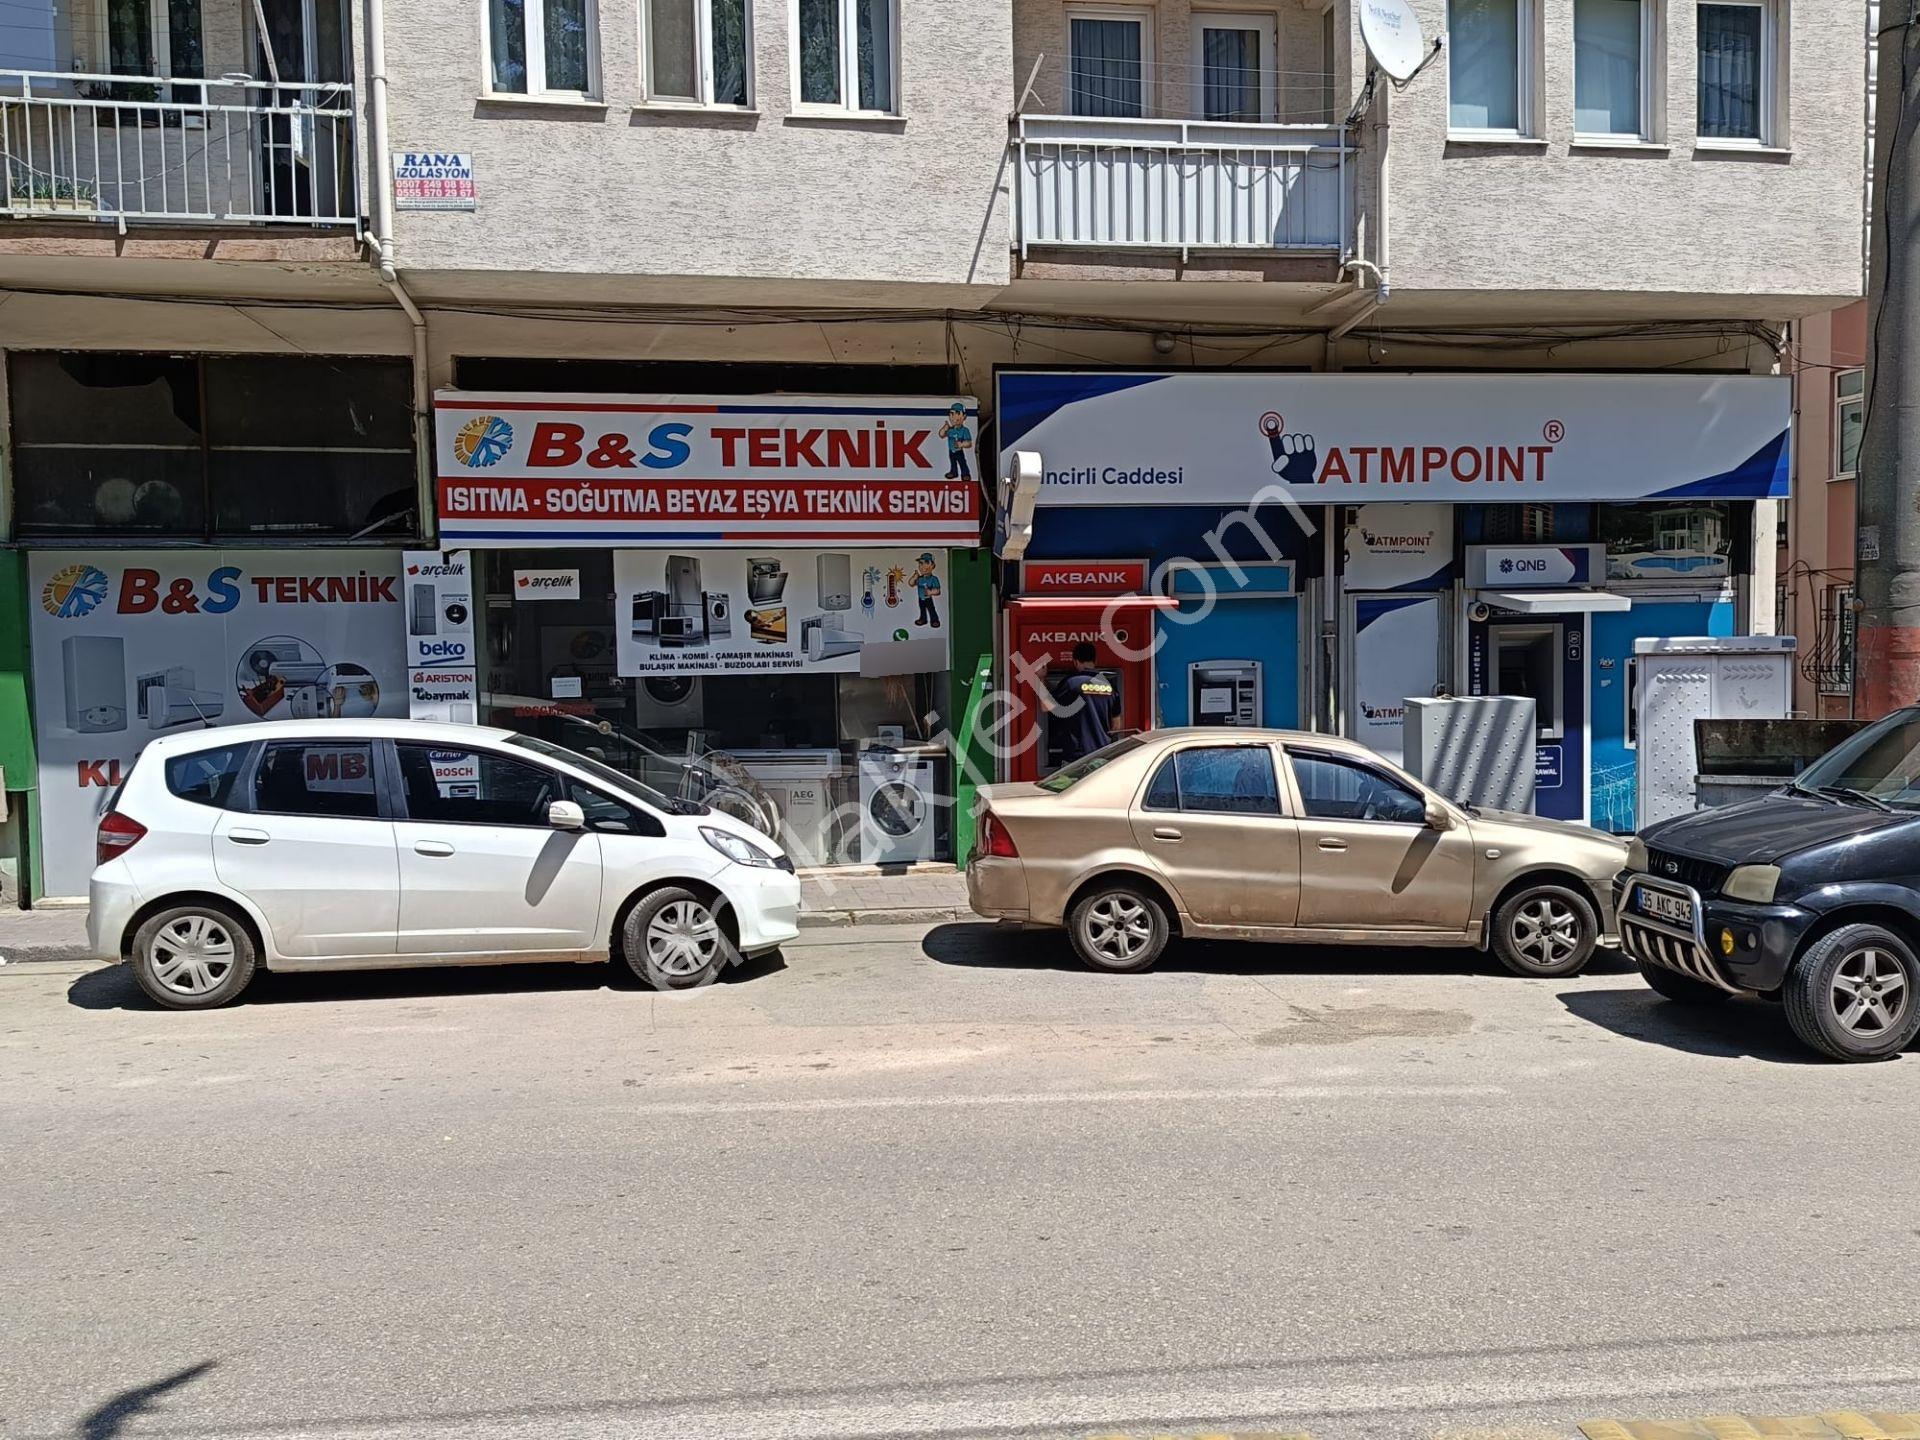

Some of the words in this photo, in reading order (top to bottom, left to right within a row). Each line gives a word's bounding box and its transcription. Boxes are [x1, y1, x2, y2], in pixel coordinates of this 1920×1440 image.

[403, 154, 462, 166] RANA
[396, 189, 421, 197] 0555
[424, 189, 442, 197] 570
[445, 189, 457, 197] 29
[460, 189, 472, 197] 67
[526, 422, 694, 468] B&S
[711, 421, 933, 468] TEKNİK
[1317, 446, 1553, 484] ATMPOINT
[1102, 467, 1183, 484] Caddesi
[446, 486, 528, 512] ISITMA
[545, 481, 662, 514] SOĞUTMA
[667, 488, 737, 514] BEYAZ
[743, 488, 799, 519] EŞYA
[804, 483, 883, 514] TEKNİK
[888, 483, 970, 514] SERVİSİ
[1375, 536, 1431, 546] ATMPOINT
[421, 563, 466, 578] arçelik
[1515, 560, 1547, 571] QNB
[531, 575, 574, 589] arçelik
[1040, 572, 1127, 584] AKBANK
[117, 566, 243, 614] B&S
[251, 570, 398, 603] TEKNİK
[1028, 632, 1106, 642] AKBANK
[419, 641, 466, 656] beko
[682, 652, 709, 660] KOMBİ
[716, 652, 752, 661] ÇAMAŞIR
[754, 650, 794, 658] MAKİNASI
[640, 663, 675, 672] BULAŞIK
[772, 660, 803, 668] SERVİSİ
[426, 674, 472, 682] ARISTON
[426, 688, 469, 701] baymak
[1375, 709, 1404, 718] ATMP
[436, 768, 472, 776] BOSCH
[1657, 896, 1672, 915] AKC
[1675, 901, 1692, 920] 943
